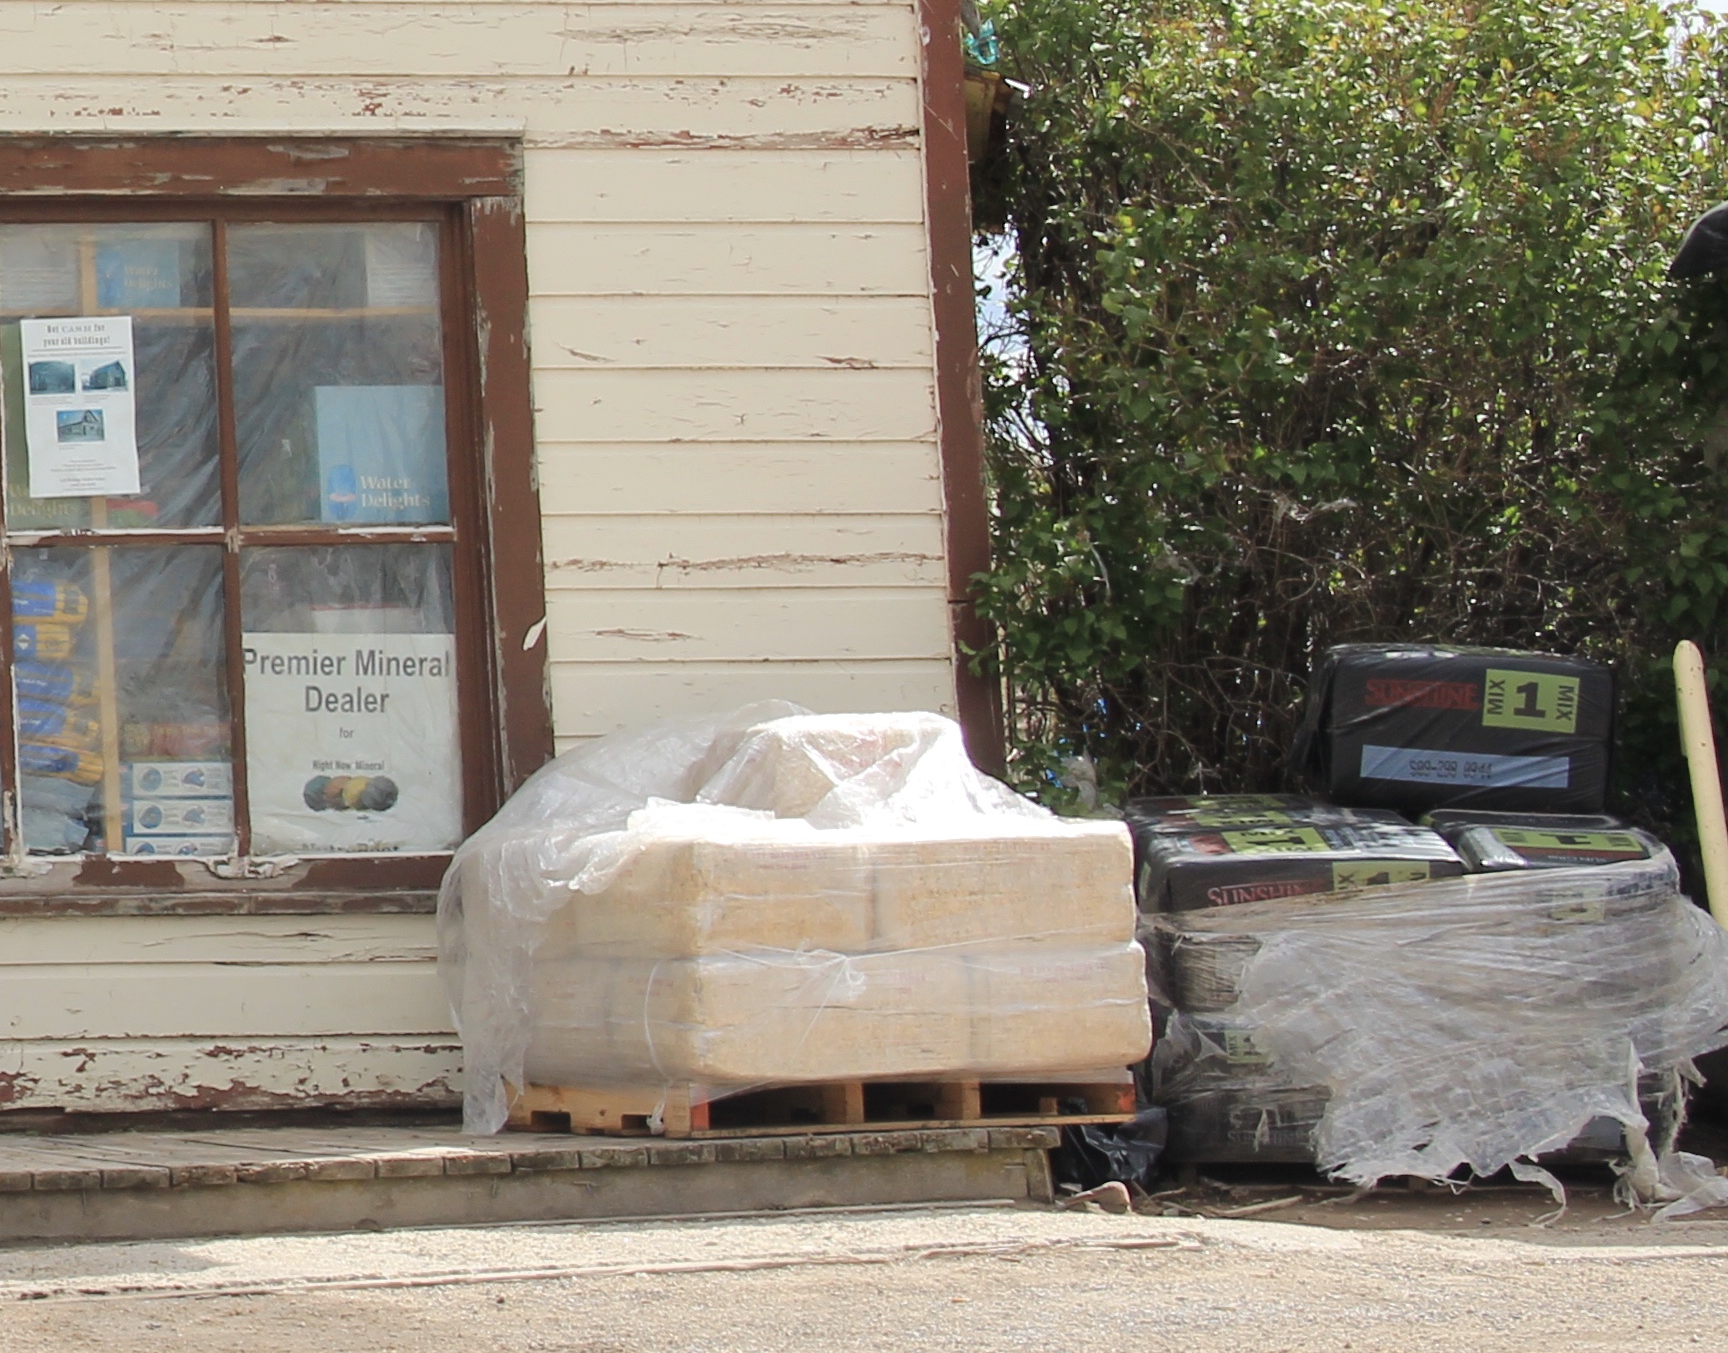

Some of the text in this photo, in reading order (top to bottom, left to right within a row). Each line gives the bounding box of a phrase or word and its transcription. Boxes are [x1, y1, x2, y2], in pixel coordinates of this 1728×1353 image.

[360, 475, 411, 489] Water
[362, 492, 431, 510] Delights
[243, 648, 450, 678] Premier Mineral
[305, 685, 390, 713] Dealer
[1364, 678, 1575, 722] SUNSHINE MIX 1 MIX
[339, 727, 354, 738] for
[355, 759, 384, 770] Mineral
